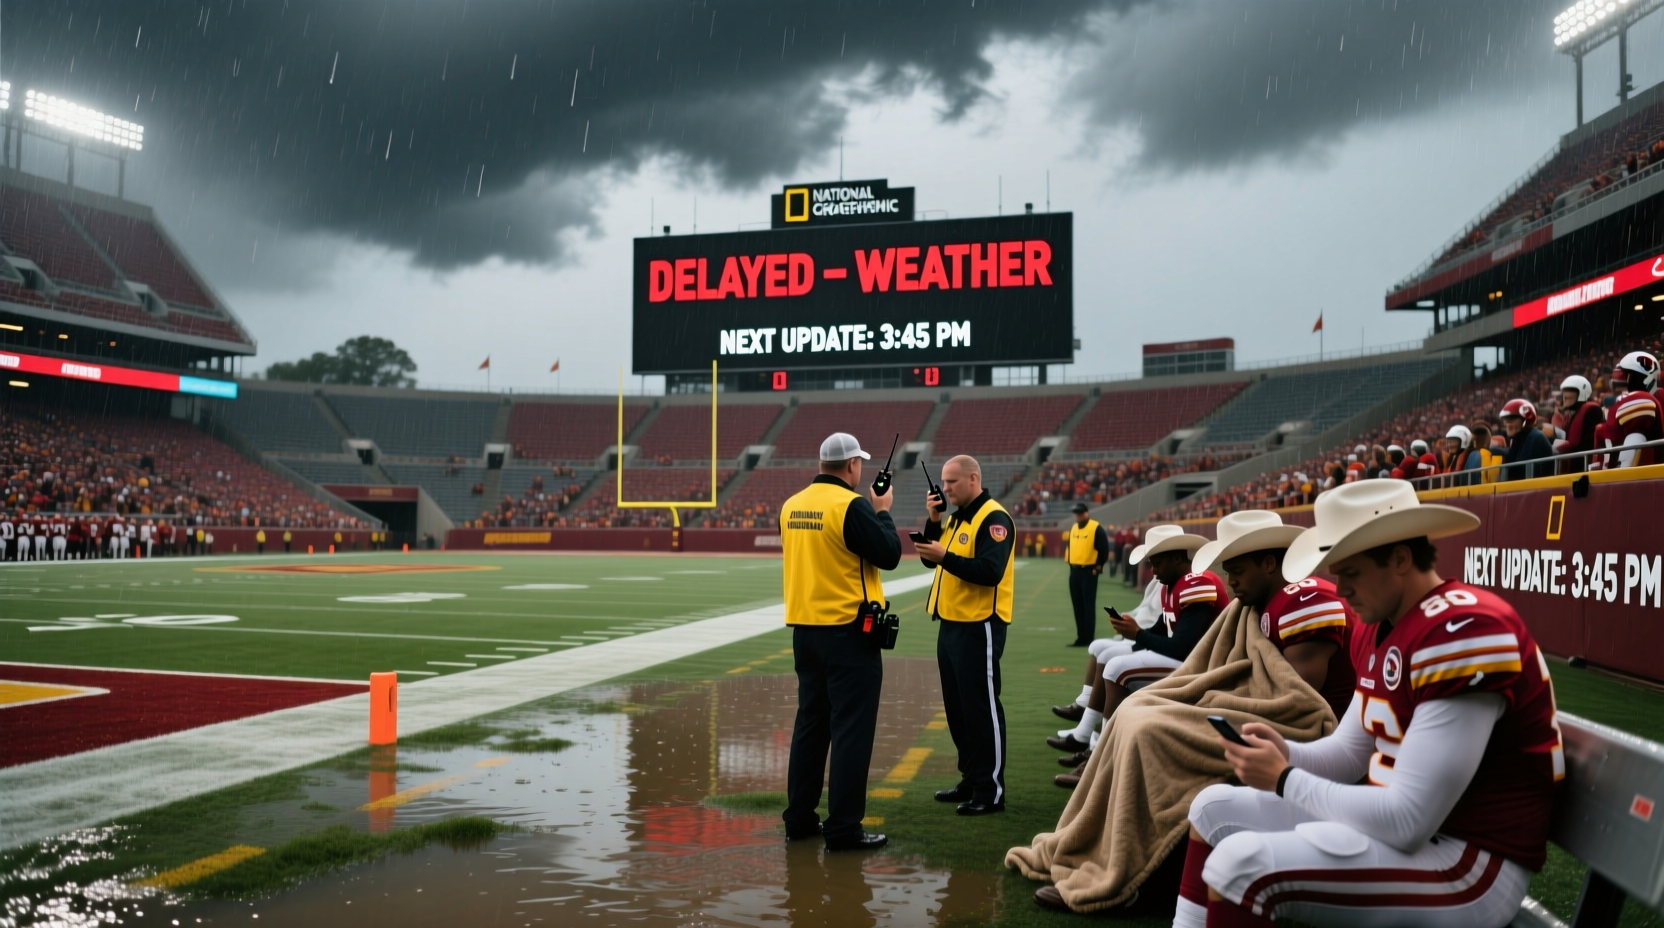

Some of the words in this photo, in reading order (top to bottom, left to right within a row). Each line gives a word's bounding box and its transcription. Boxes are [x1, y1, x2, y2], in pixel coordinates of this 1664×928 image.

[813, 185, 875, 203] NATIONAL
[649, 253, 814, 302] DELAYED
[855, 240, 1053, 293] WEATHER
[720, 328, 776, 355] NEXT
[782, 324, 875, 353] UPDATE:
[880, 322, 931, 349] 3:45
[937, 320, 971, 347] PM
[1463, 546, 1499, 587] NEXT
[1501, 548, 1567, 596] UPDATE:
[1571, 551, 1619, 603] 3:45
[1623, 553, 1662, 608] PM
